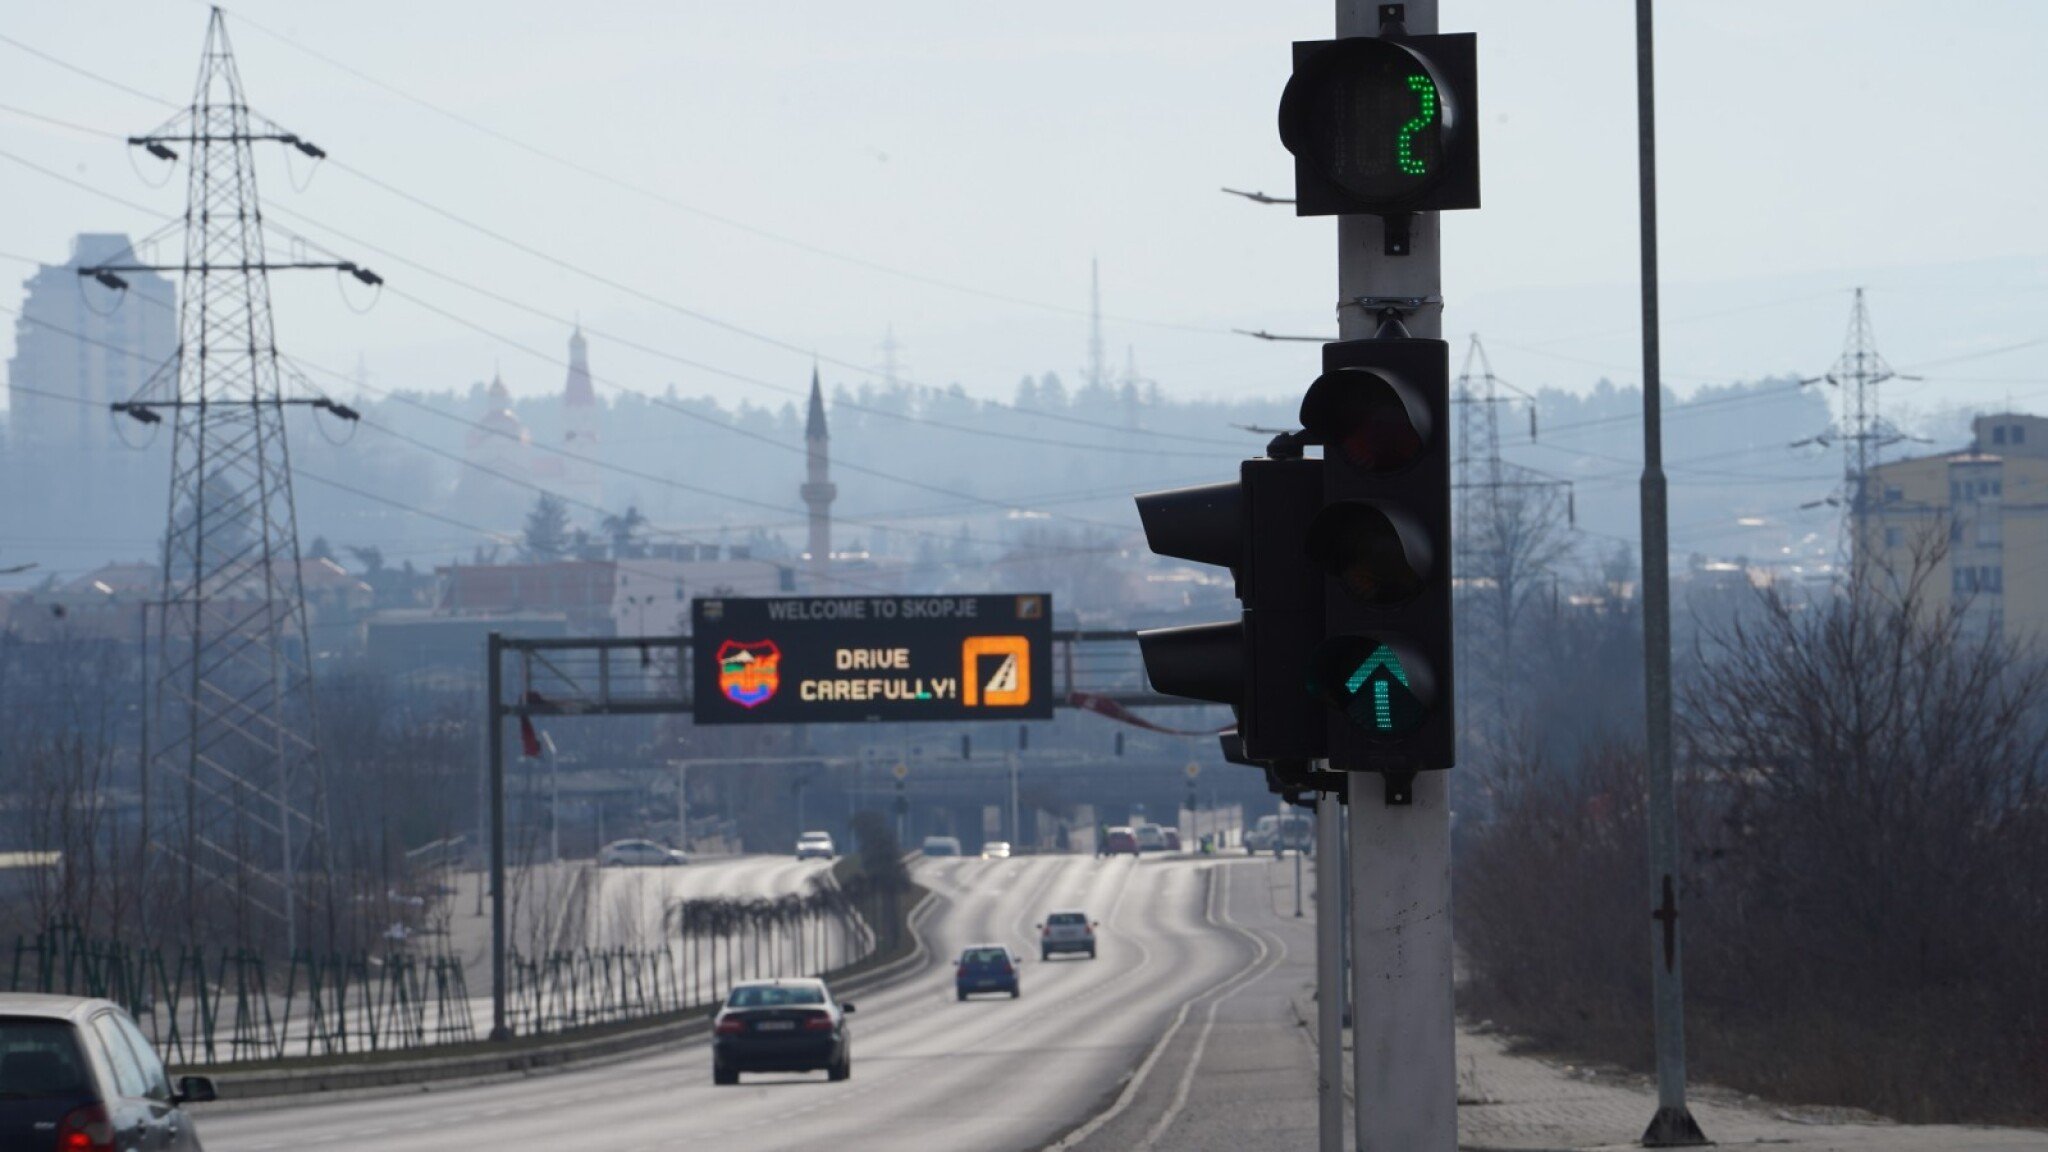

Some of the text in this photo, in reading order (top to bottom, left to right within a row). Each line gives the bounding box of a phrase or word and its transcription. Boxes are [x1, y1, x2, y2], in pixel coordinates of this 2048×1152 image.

[1399, 76, 1434, 174] 2
[768, 599, 977, 620] WELCOME TO SKOPJE
[836, 648, 909, 670] DRIVE
[801, 678, 956, 701] CAREFULLY!
